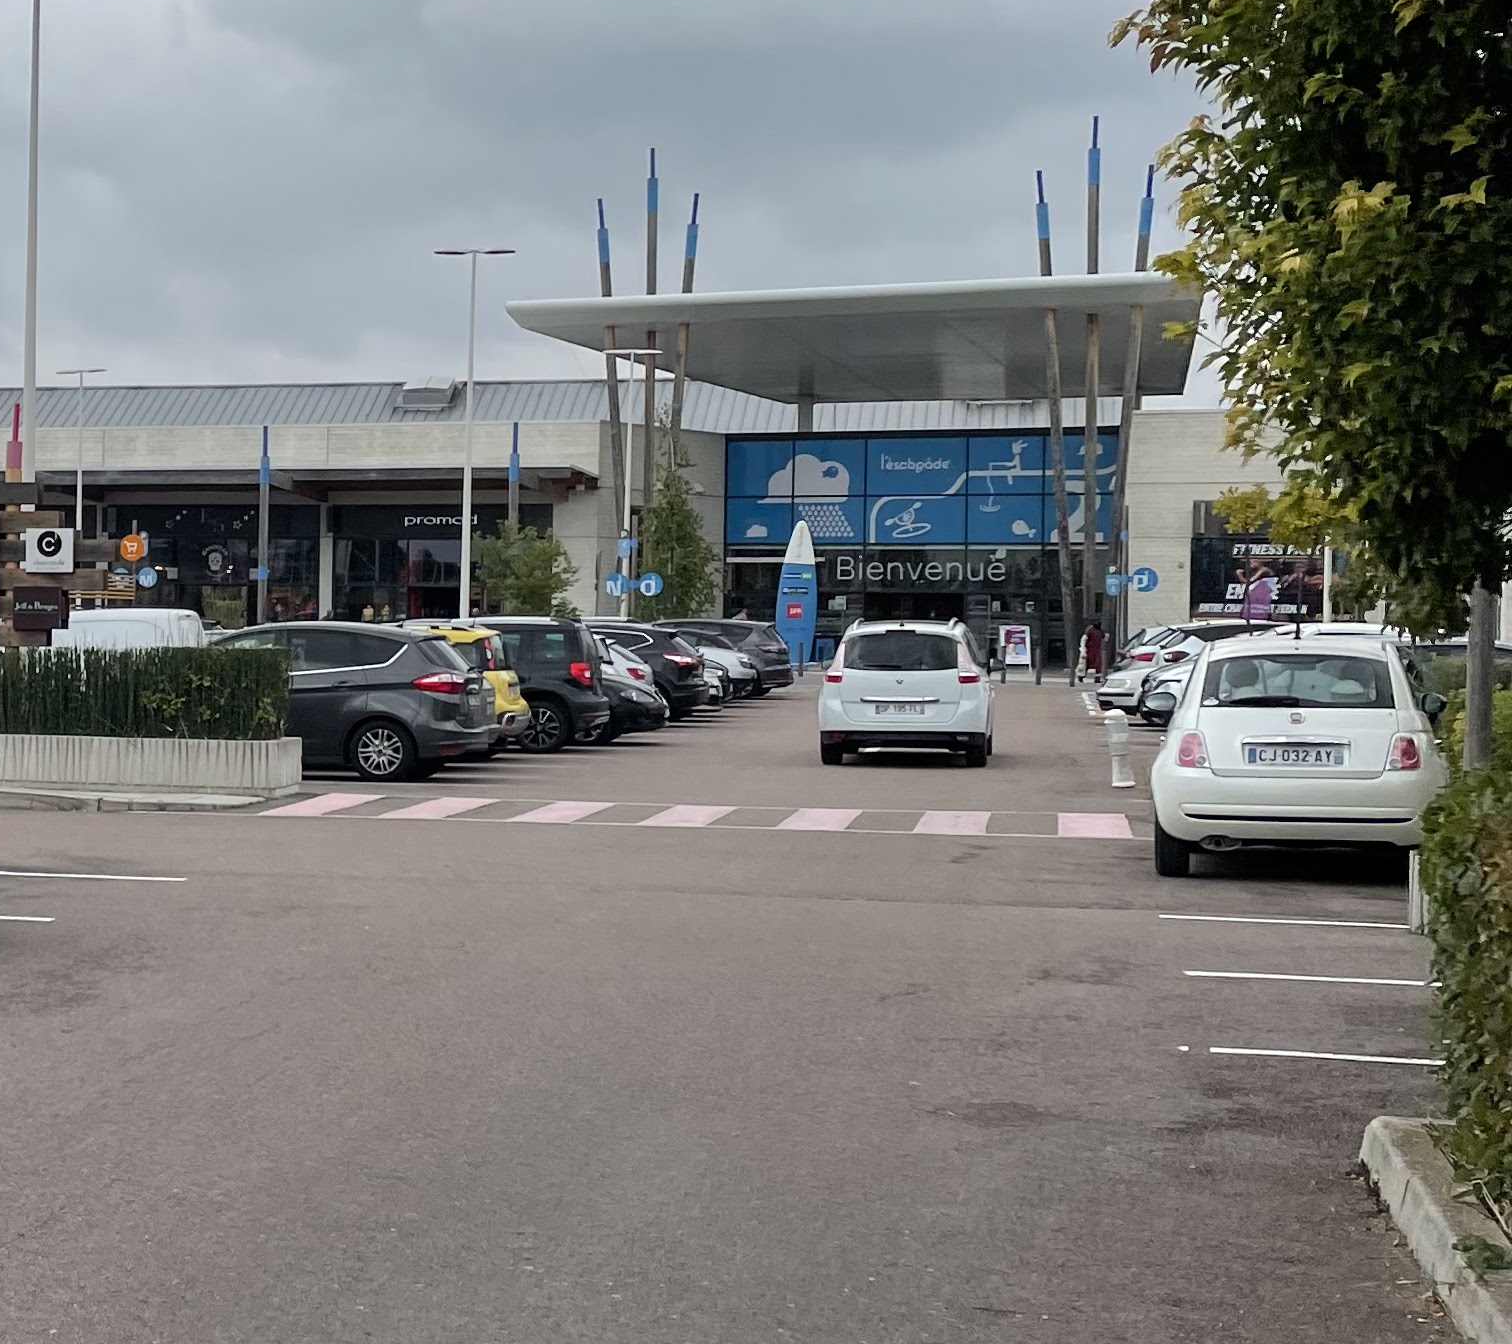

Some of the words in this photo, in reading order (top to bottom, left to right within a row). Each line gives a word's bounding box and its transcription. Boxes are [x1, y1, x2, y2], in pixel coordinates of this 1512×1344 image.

[1050, 480, 1104, 543] 2
[836, 555, 1006, 581] Bienvenue
[1258, 748, 1332, 763] CJ-032-AY
